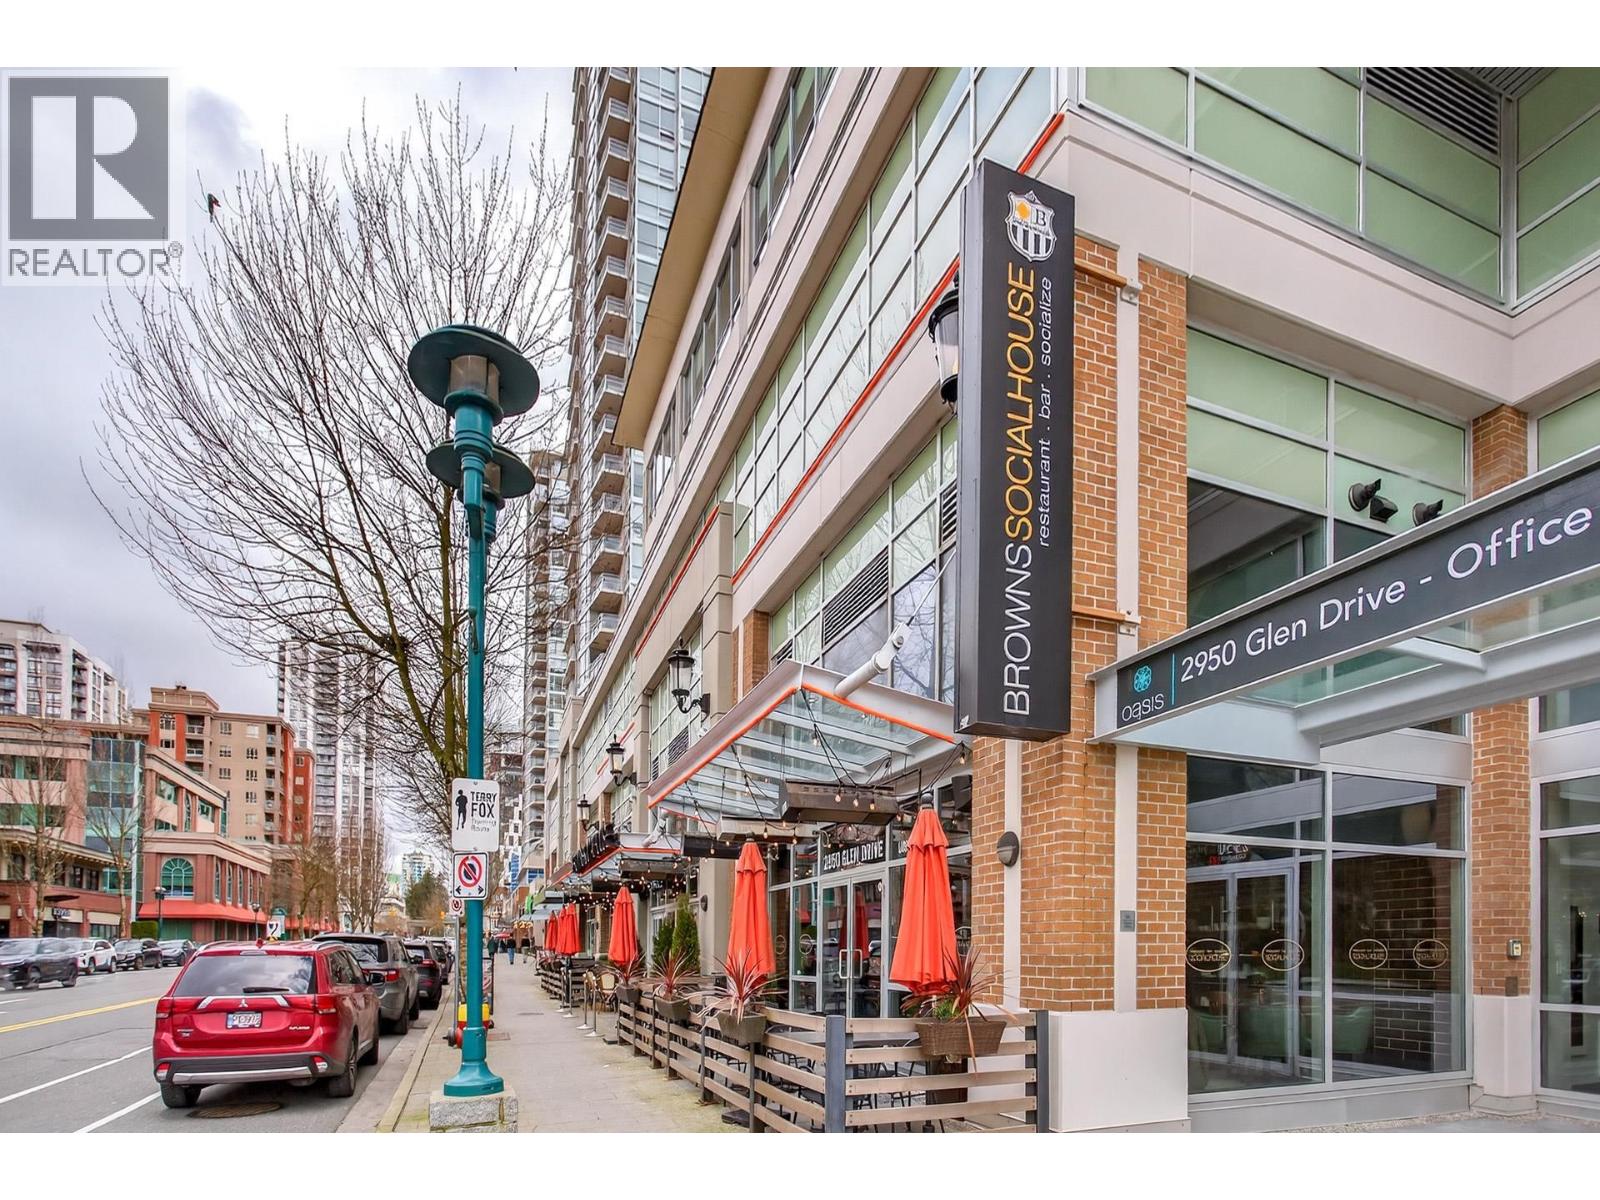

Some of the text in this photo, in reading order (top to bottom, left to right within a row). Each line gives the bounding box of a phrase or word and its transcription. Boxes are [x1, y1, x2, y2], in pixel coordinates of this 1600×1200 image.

[1038, 276, 1052, 366] socialize
[1039, 438, 1051, 547] restaurant
[1181, 639, 1237, 683] 2950
[1245, 618, 1307, 657] Glen
[1319, 580, 1406, 631] Drive
[1447, 507, 1593, 579] Office
[1121, 693, 1165, 723] oasis
[470, 791, 497, 803] TERRY
[471, 802, 495, 818] FOX
